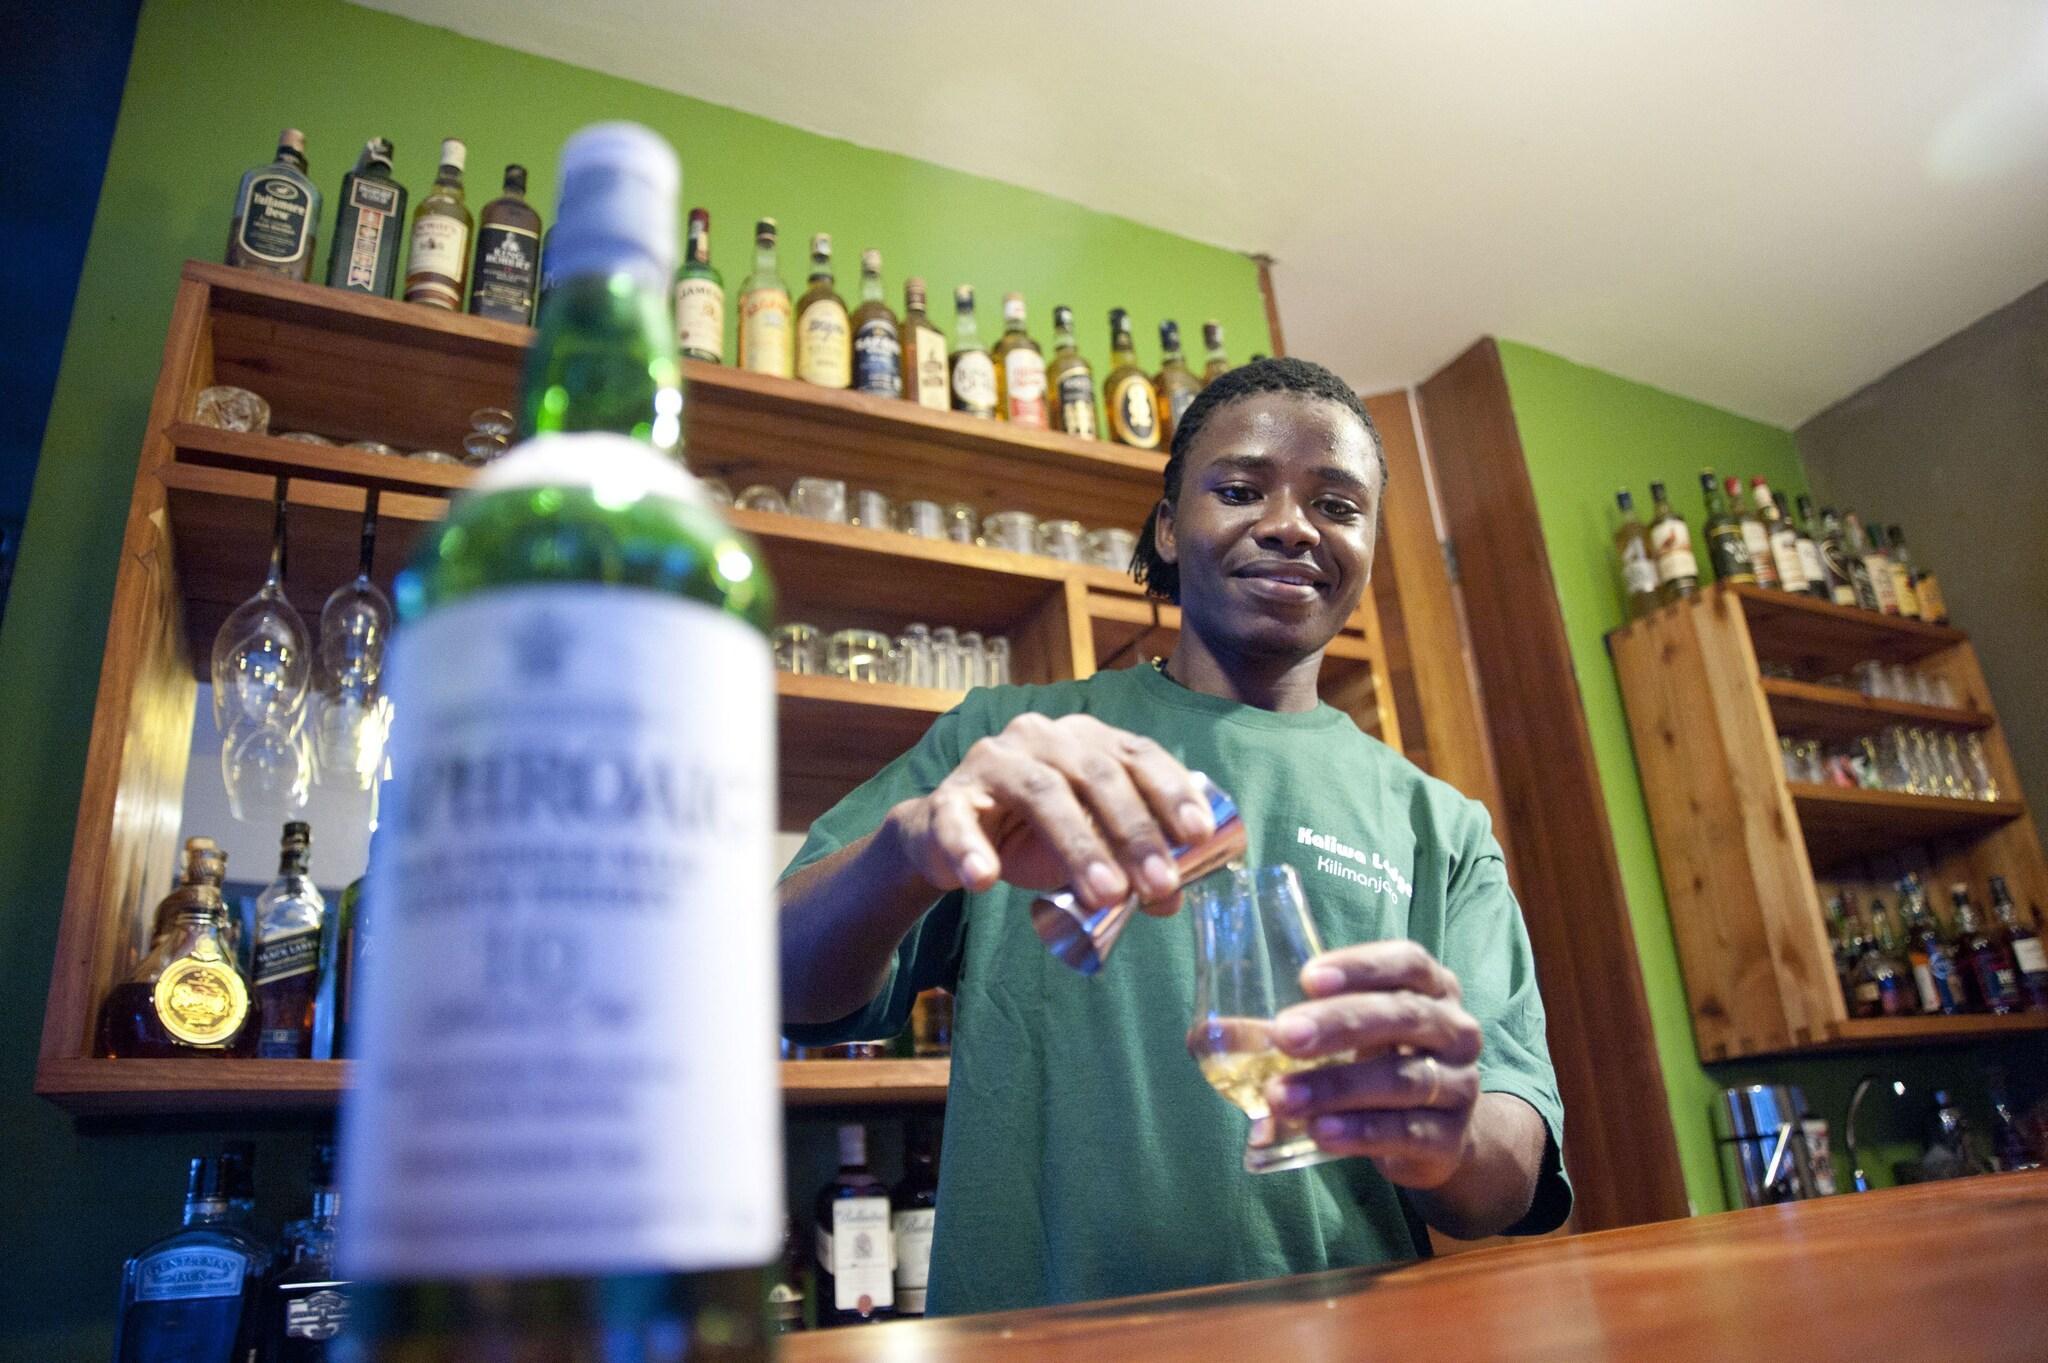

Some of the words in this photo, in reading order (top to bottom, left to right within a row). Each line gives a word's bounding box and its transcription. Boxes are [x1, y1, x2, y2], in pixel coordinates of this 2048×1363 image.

[264, 206, 289, 221] Dew
[1297, 826, 1366, 865] Kaliwa
[1317, 855, 1398, 905] Kilimanjao
